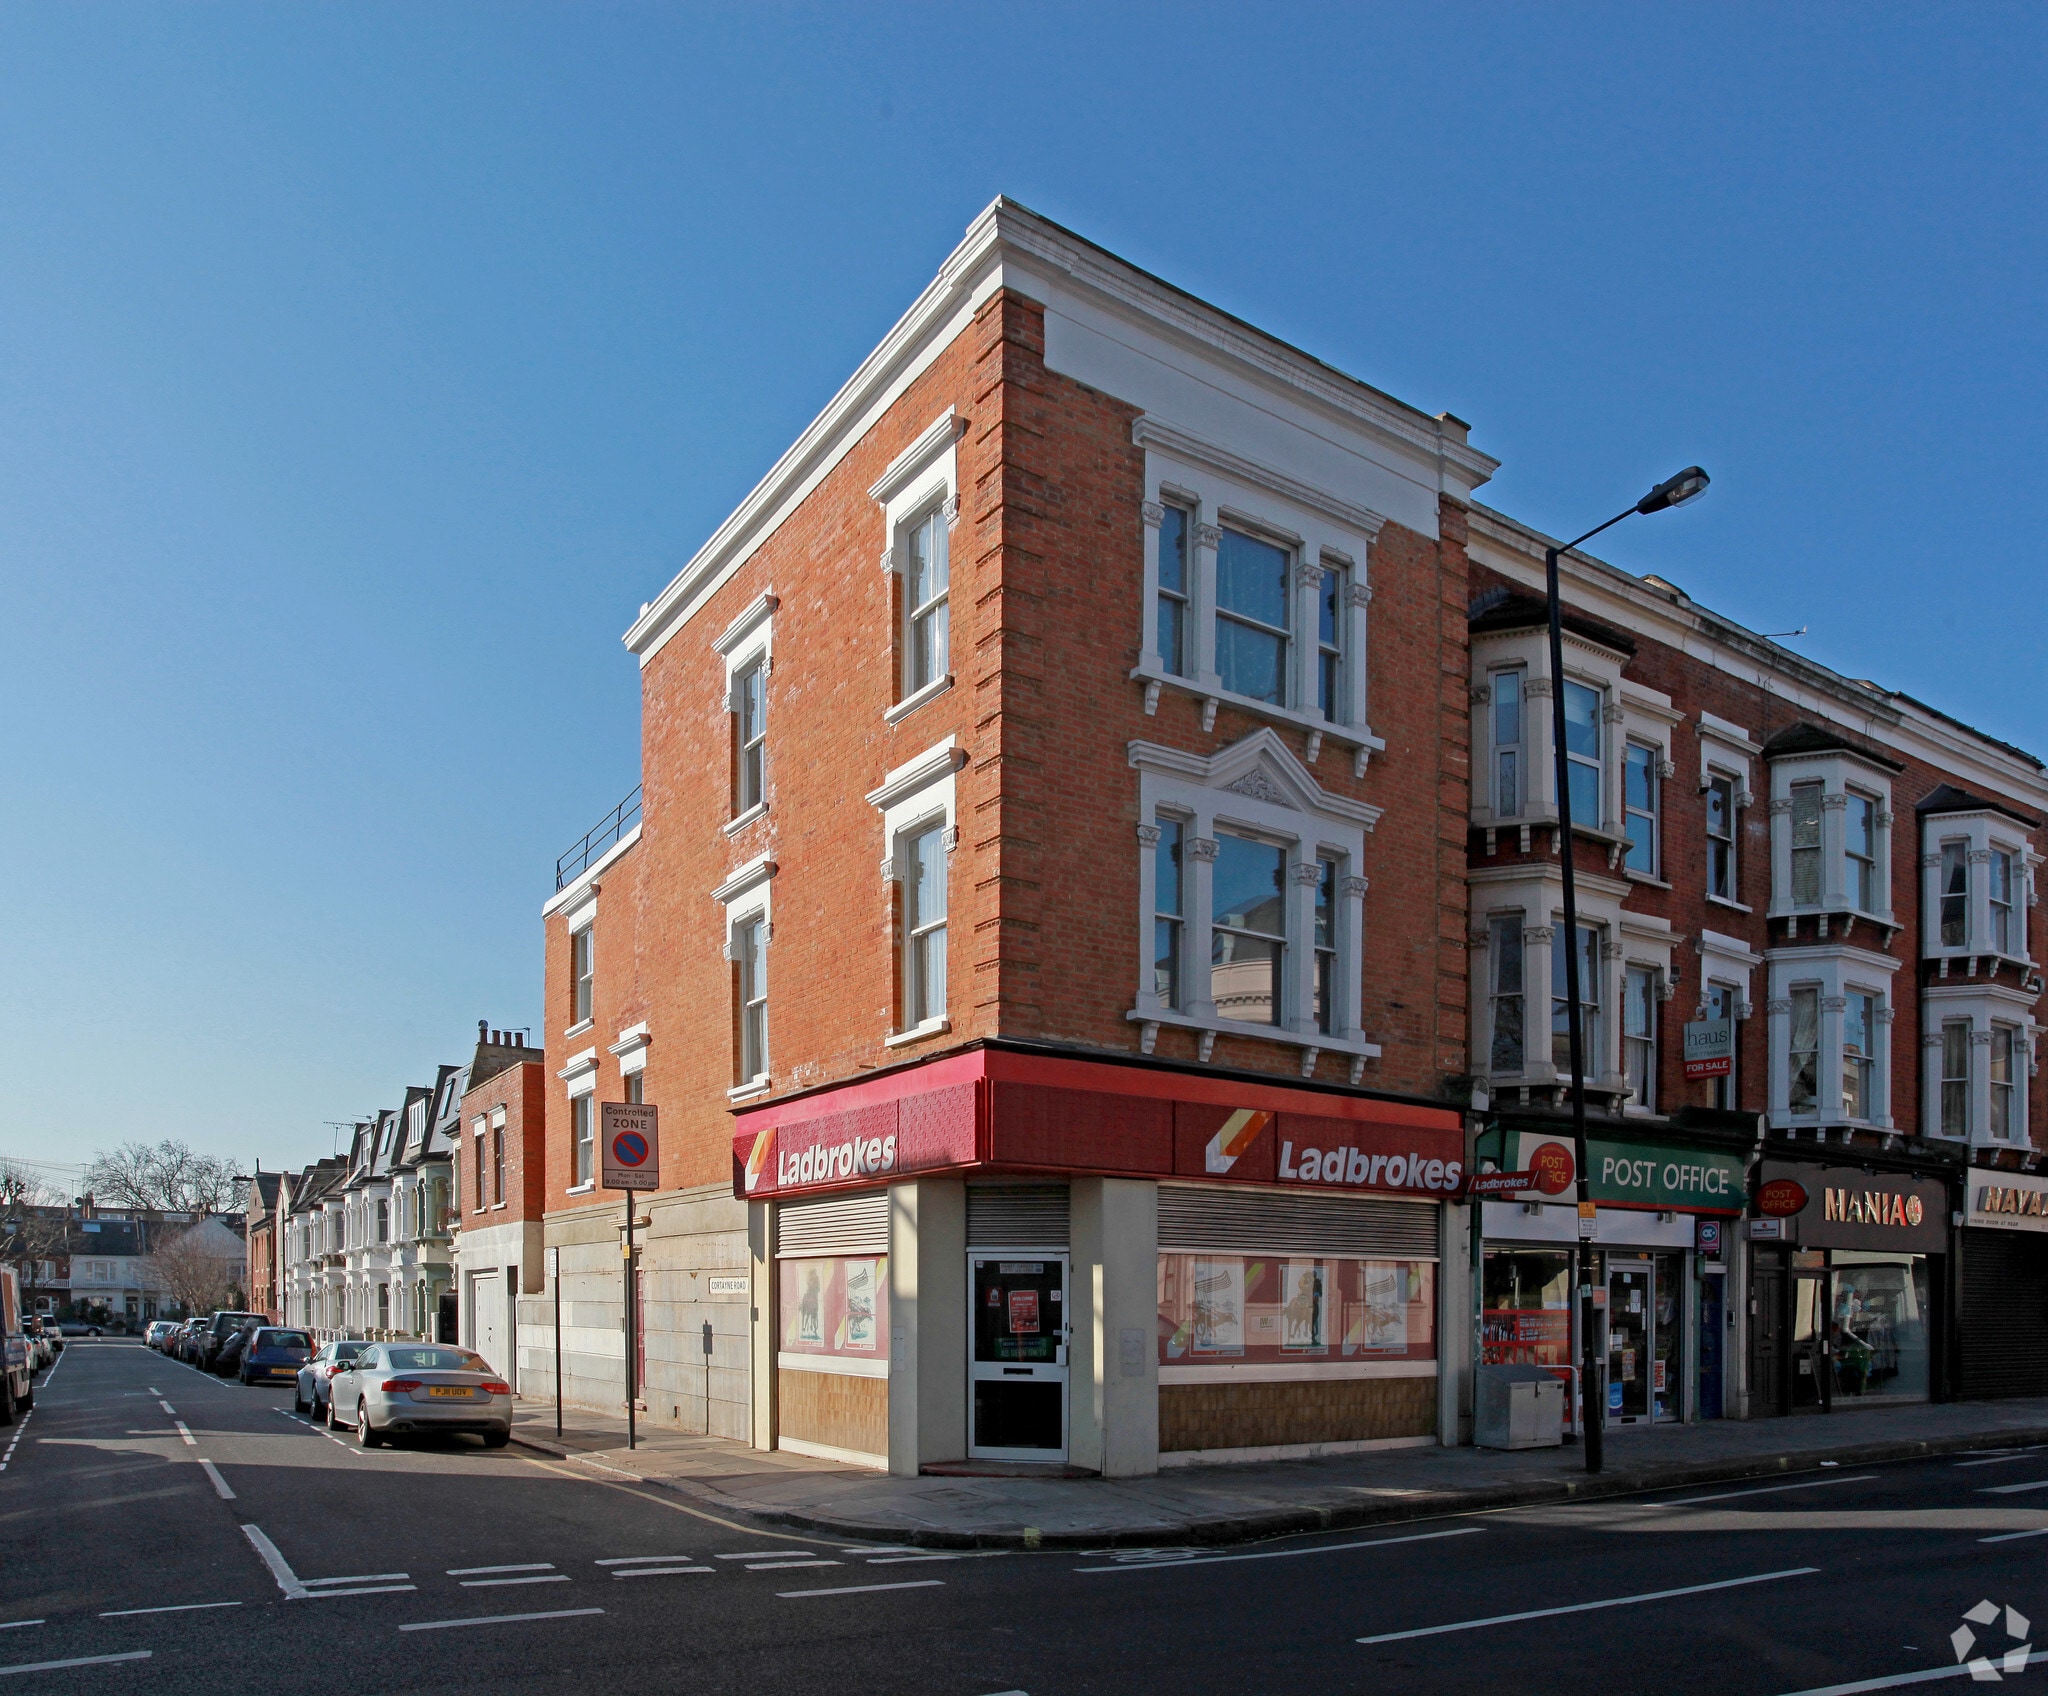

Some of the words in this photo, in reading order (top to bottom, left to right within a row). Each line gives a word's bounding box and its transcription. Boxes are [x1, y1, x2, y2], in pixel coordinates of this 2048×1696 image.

[1688, 1022, 1728, 1046] haus
[1686, 1063, 1704, 1073] FOR
[1705, 1061, 1728, 1070] SALE
[605, 1106, 654, 1117] Controlled
[613, 1118, 647, 1129] ZONE
[777, 1135, 897, 1186] Ladbrokes
[1278, 1140, 1462, 1191] Ladbrokes
[1541, 1155, 1565, 1170] POST
[1602, 1157, 1657, 1189] POST
[1663, 1163, 1729, 1195] OFFICE
[1475, 1178, 1529, 1191] Ladbrokes
[1765, 1189, 1792, 1199] POST
[1761, 1199, 1796, 1209] OFFICE
[734, 1280, 746, 1289] ROAD
